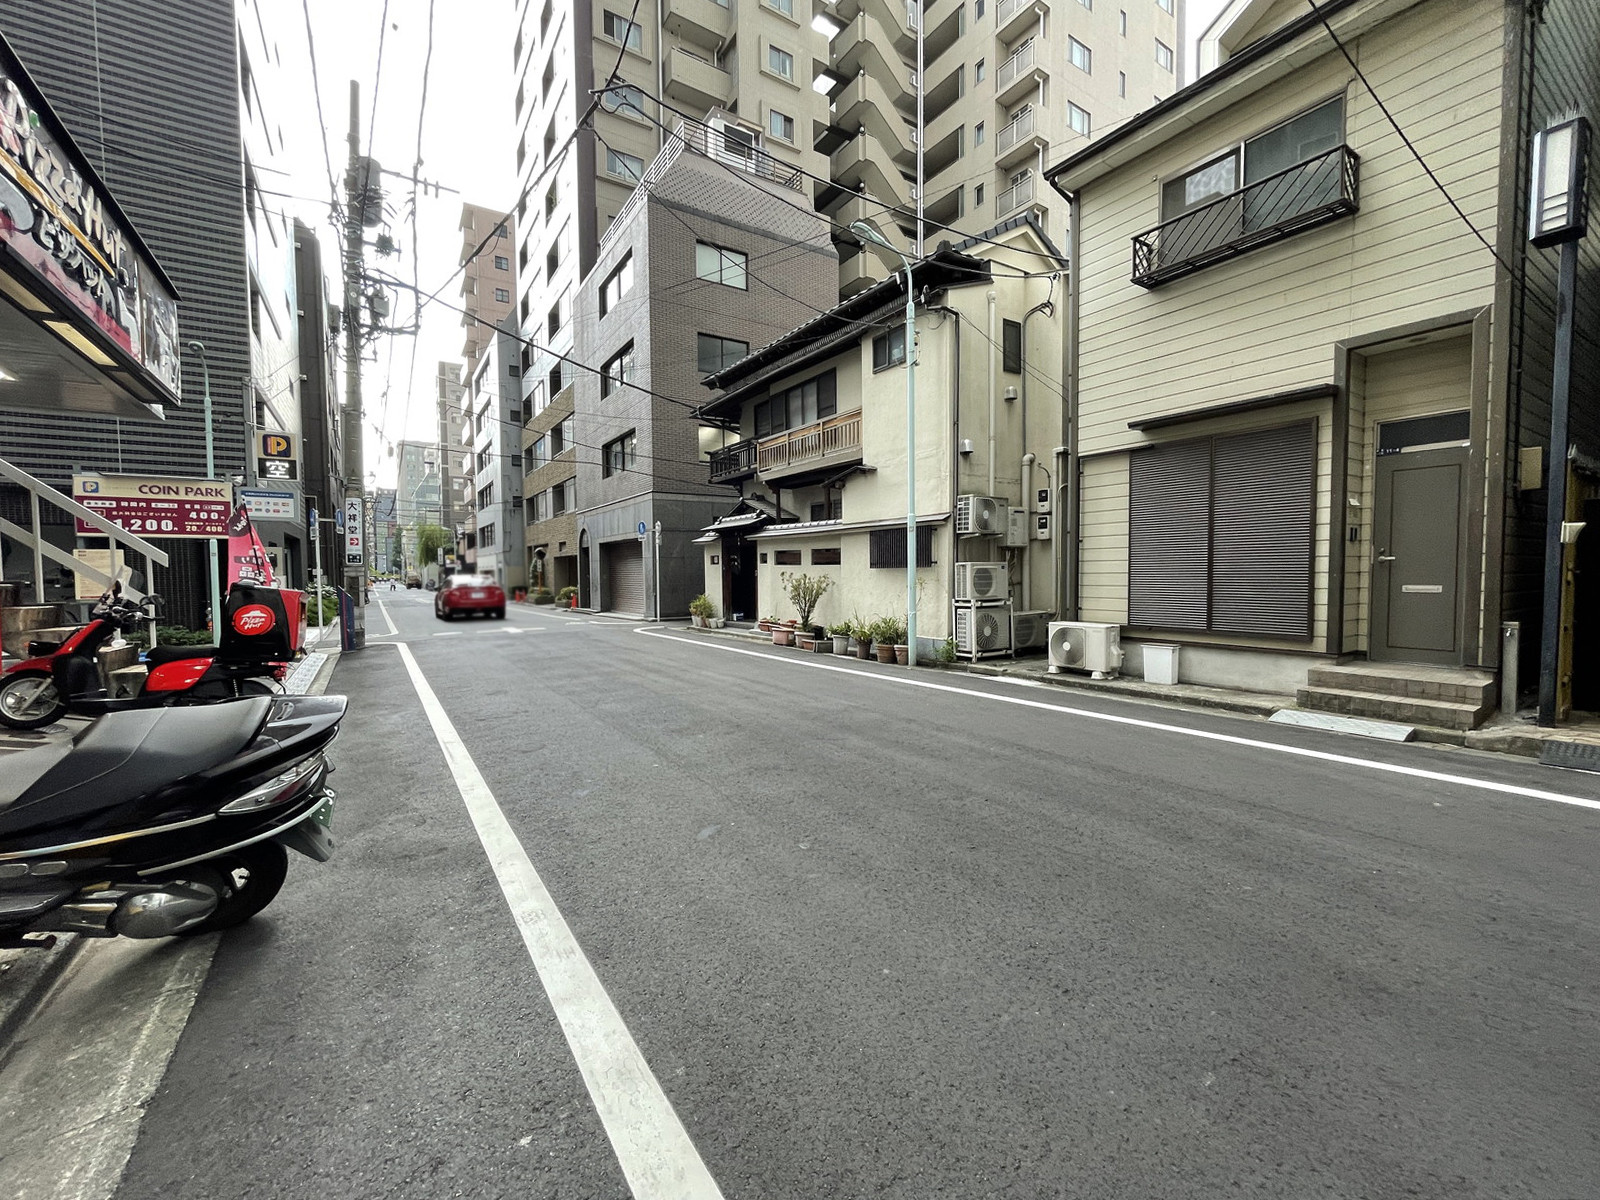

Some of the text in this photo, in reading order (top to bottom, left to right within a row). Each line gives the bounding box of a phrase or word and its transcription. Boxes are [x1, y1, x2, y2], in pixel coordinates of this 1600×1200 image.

[80, 185, 127, 269] Hut
[266, 461, 290, 478] 空
[138, 484, 226, 498] COIN PARK
[348, 501, 358, 534] 大祥堂
[240, 616, 266, 626] Pizza
[244, 621, 264, 630] Hut
